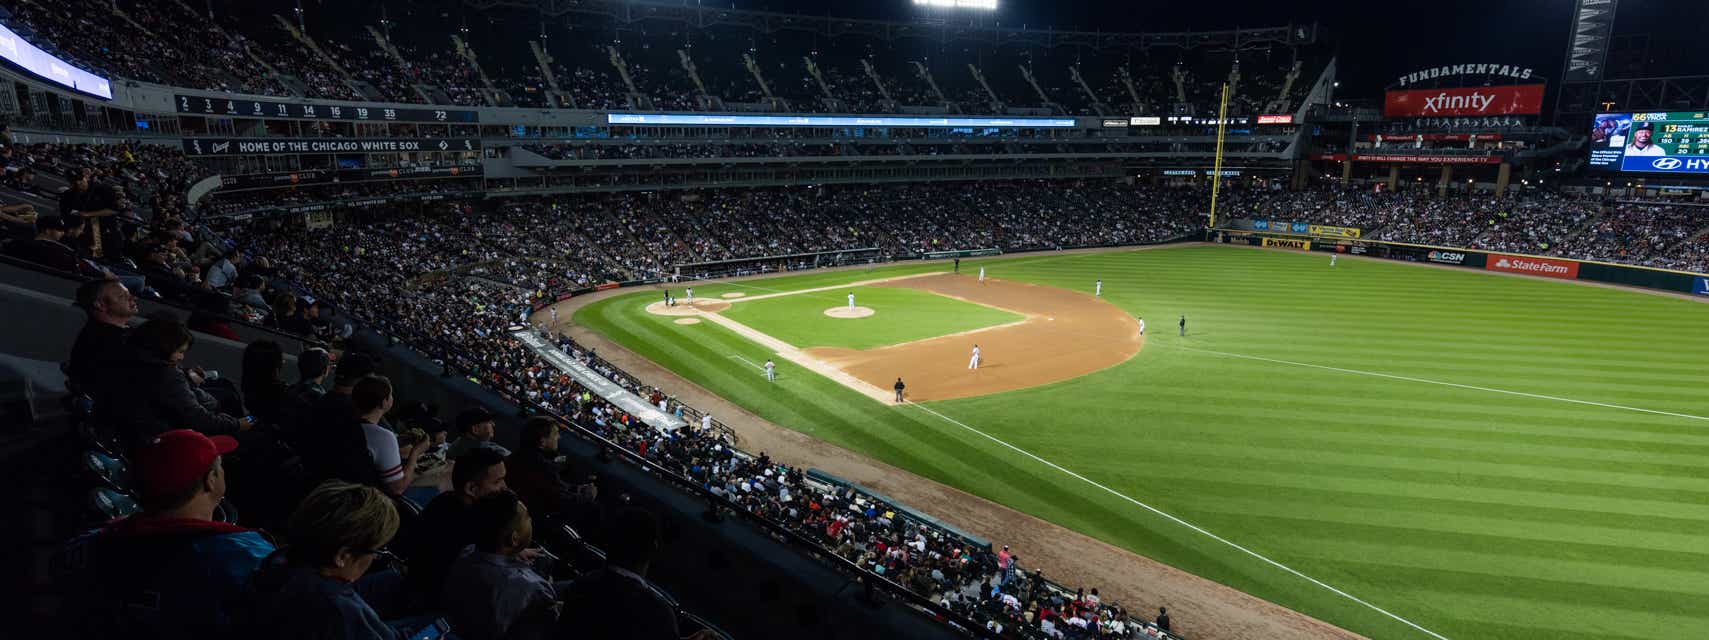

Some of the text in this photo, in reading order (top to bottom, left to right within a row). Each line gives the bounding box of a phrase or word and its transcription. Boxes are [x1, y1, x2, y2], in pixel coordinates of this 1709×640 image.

[1399, 63, 1532, 86] FUNDAMENTALS
[182, 96, 189, 107] 2
[205, 99, 212, 109] 3
[227, 101, 234, 111] 4
[1423, 91, 1496, 113] xfinity
[254, 102, 261, 112] 9
[278, 104, 287, 114] 11
[303, 105, 314, 114] 14
[330, 107, 340, 115] 16
[357, 108, 368, 116] 19
[384, 109, 396, 117] 35
[435, 111, 447, 119] 72
[1633, 113, 1646, 121] 66
[240, 142, 419, 152] HOME OF THE CHICAGO WHITE SOX
